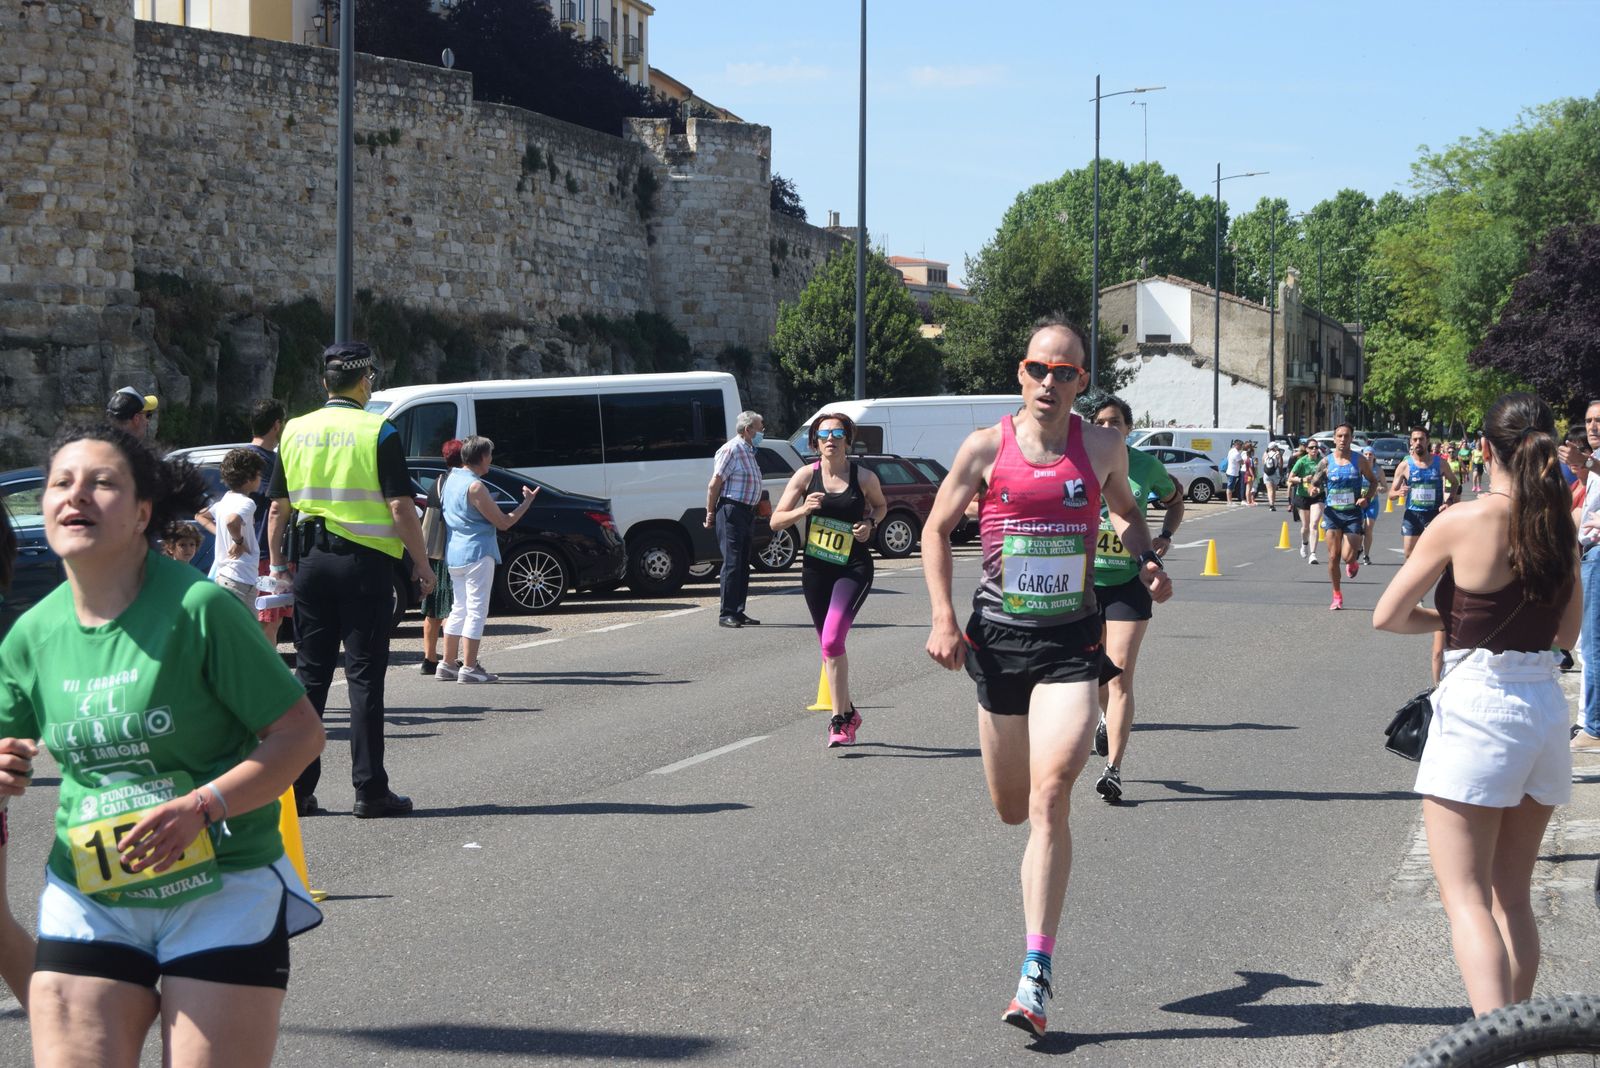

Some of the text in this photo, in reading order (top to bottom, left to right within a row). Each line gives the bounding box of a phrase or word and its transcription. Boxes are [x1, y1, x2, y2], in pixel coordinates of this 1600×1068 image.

[817, 528, 844, 550] 110
[1018, 573, 1069, 593] GARGAR
[1051, 597, 1078, 608] RURAL
[87, 668, 138, 691] CARRERA
[92, 742, 150, 760] ZAMORA
[100, 777, 175, 803] FUNDACION
[102, 789, 178, 816] CAJA RURAL
[158, 872, 213, 899] RURAL
